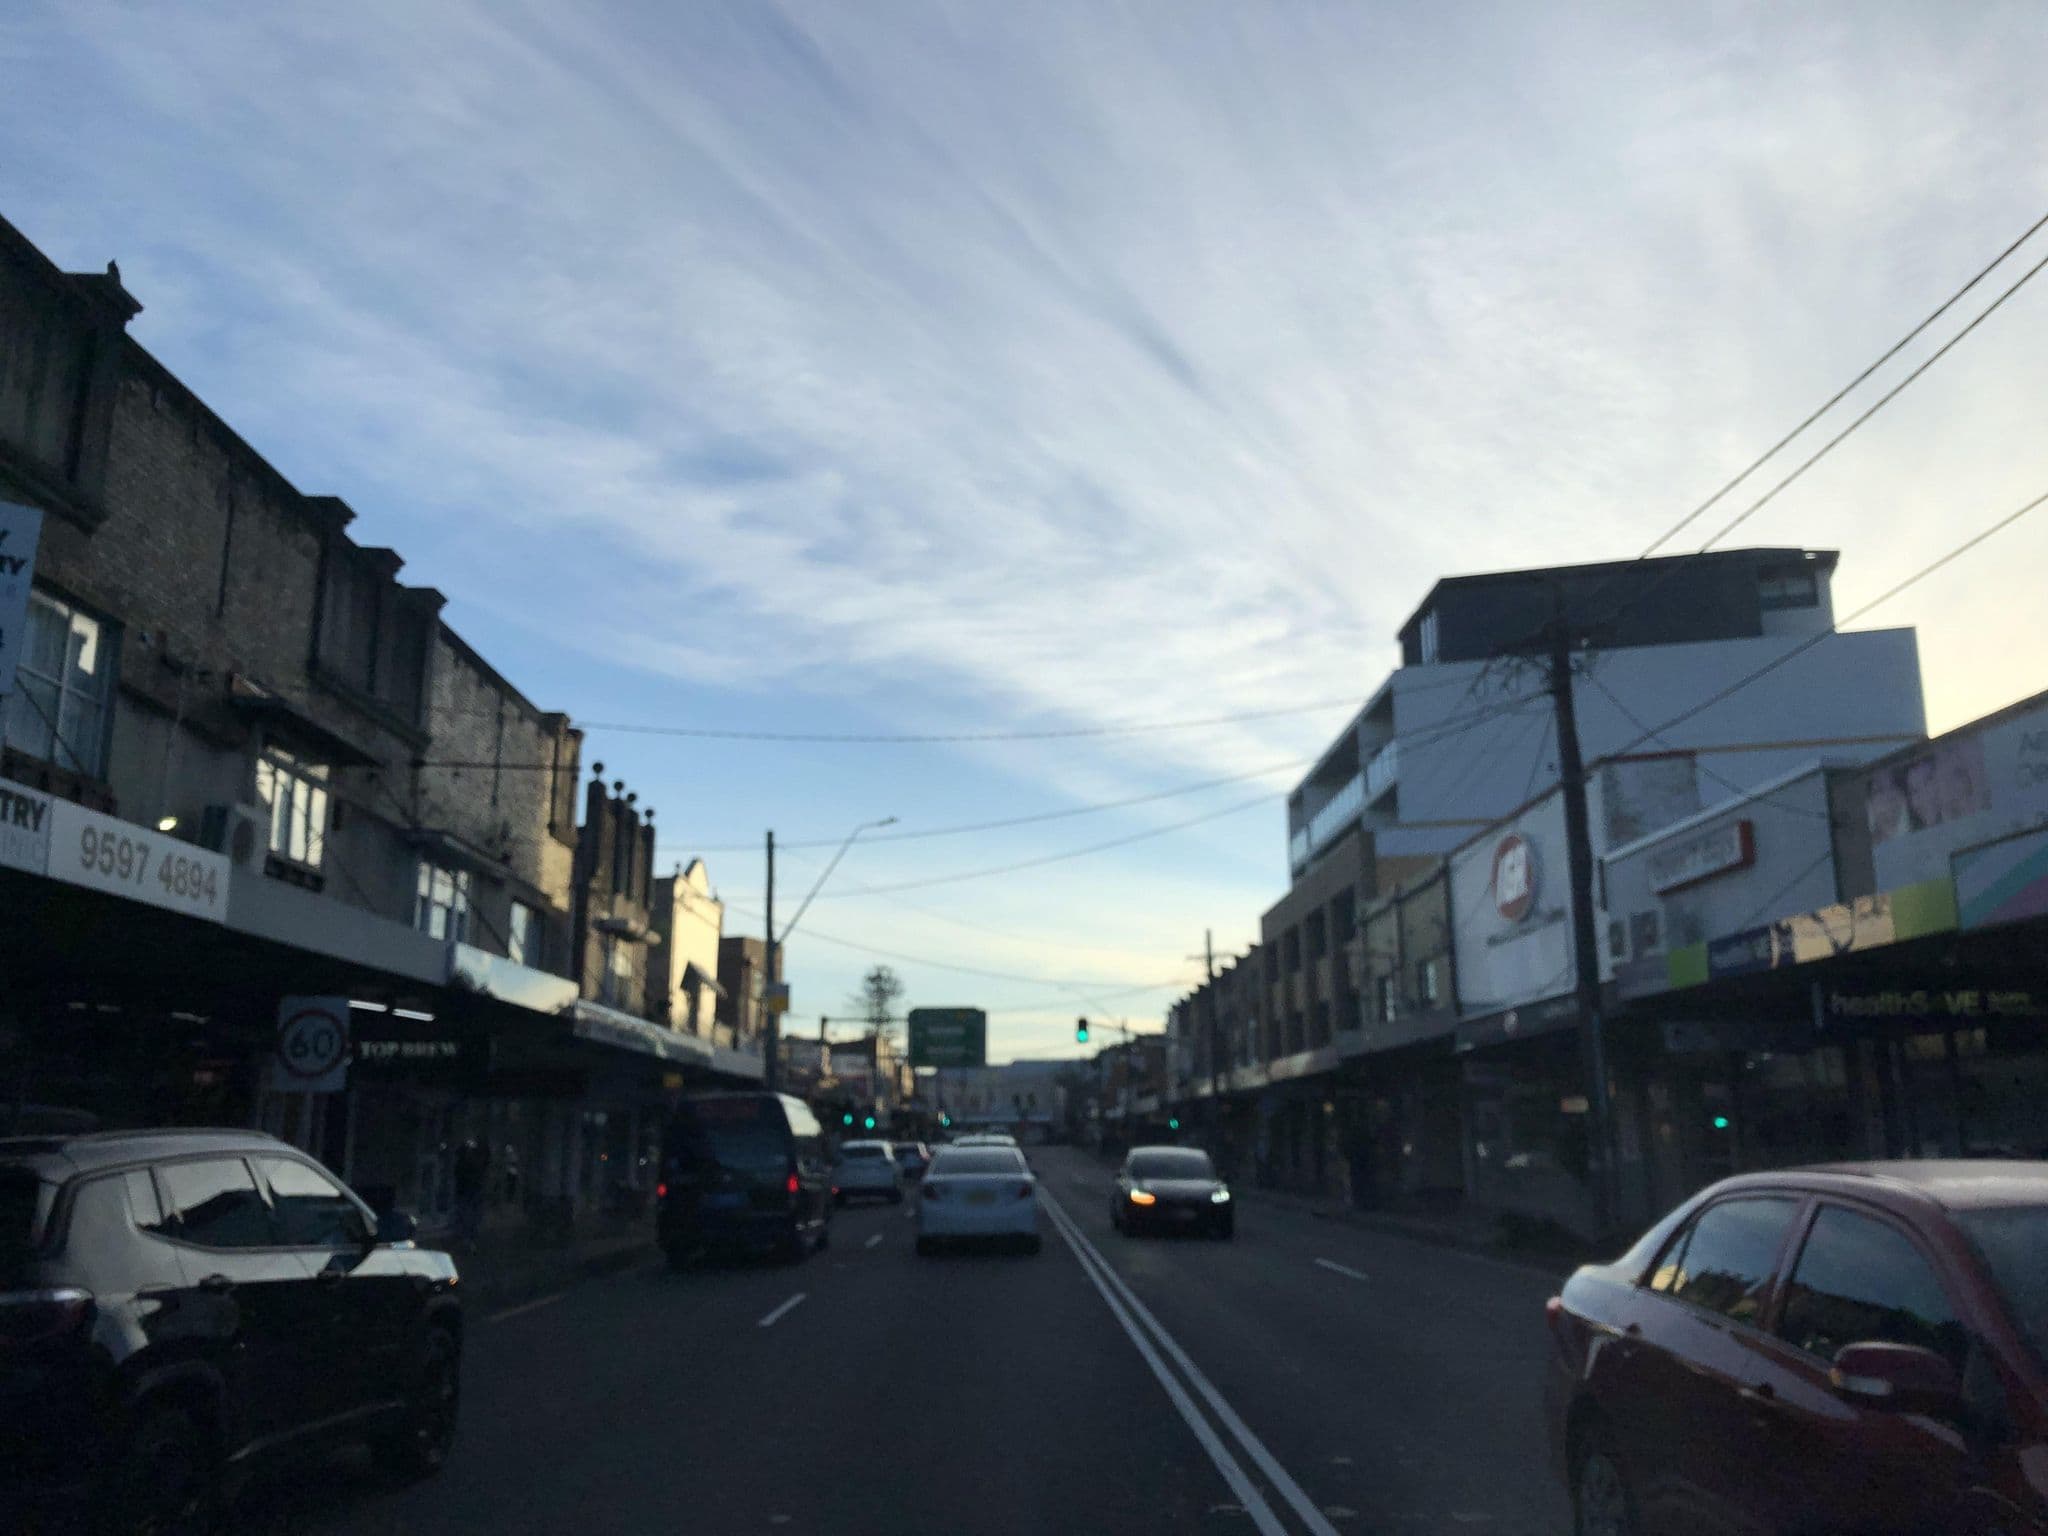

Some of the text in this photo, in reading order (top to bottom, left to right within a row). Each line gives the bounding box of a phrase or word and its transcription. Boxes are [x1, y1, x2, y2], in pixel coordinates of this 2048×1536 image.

[80, 824, 218, 905] 9597 4894
[1831, 990, 1980, 1016] healthSVE
[290, 1028, 335, 1058] 60
